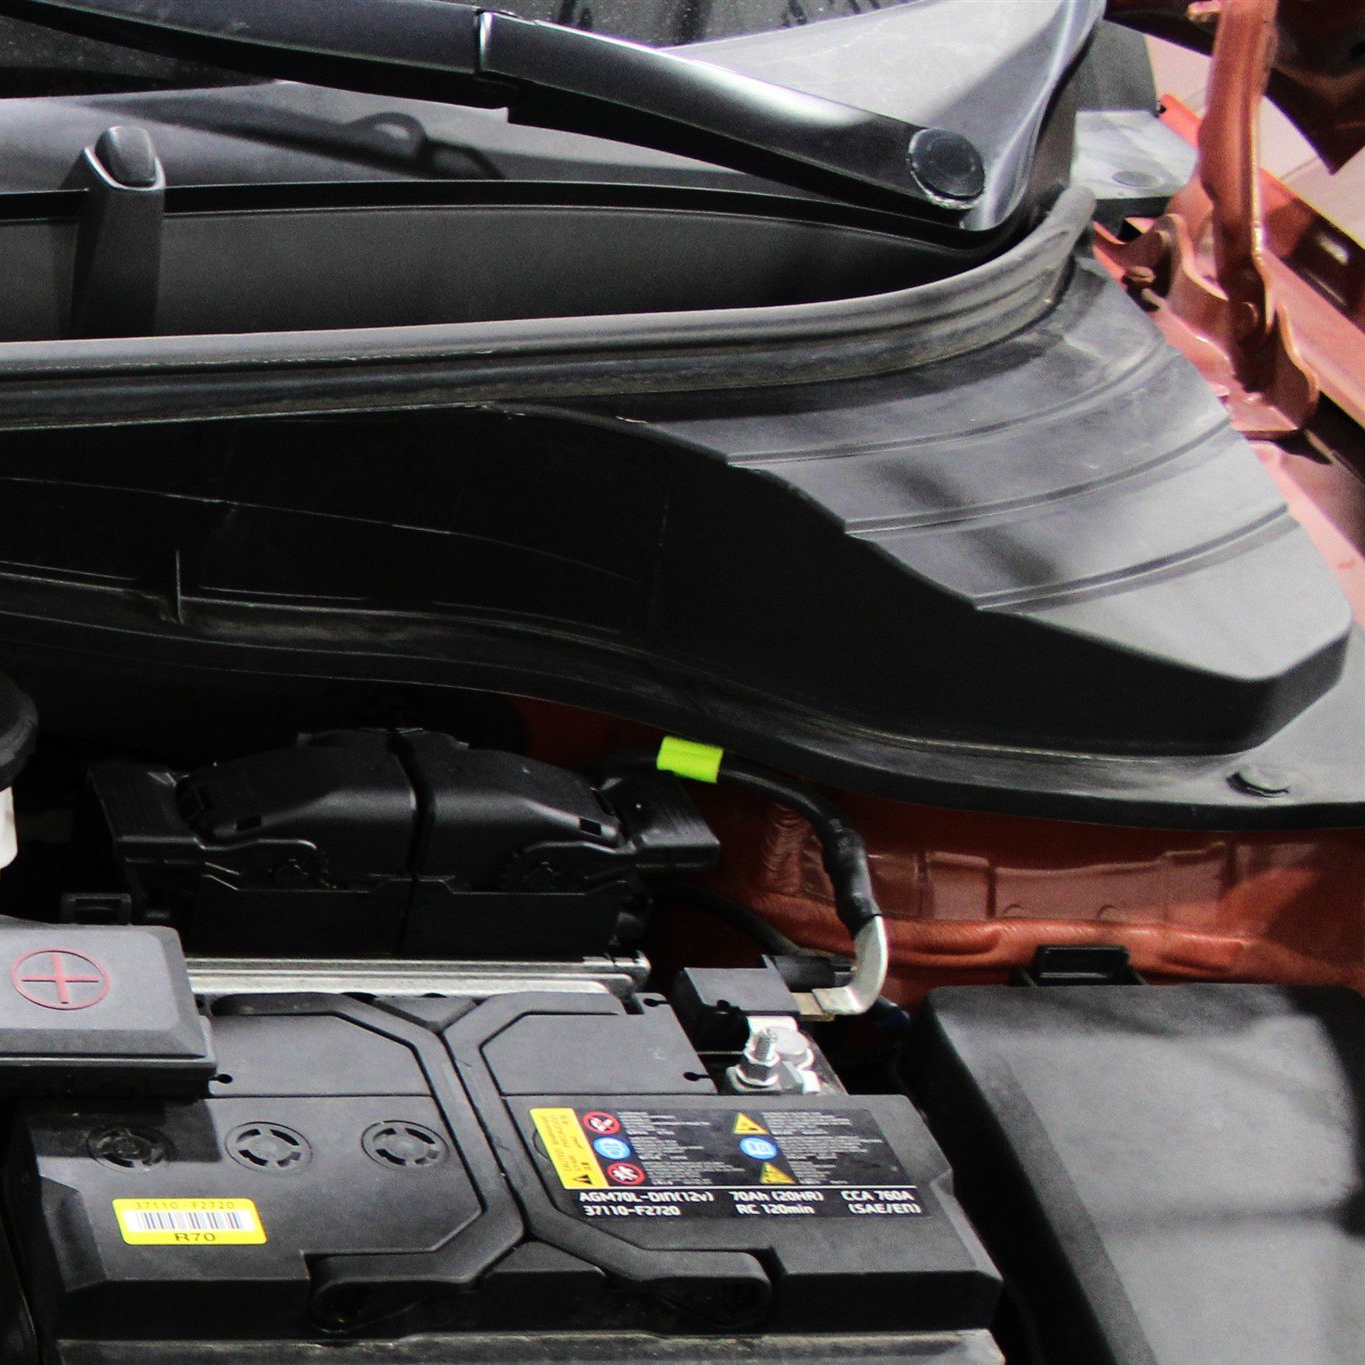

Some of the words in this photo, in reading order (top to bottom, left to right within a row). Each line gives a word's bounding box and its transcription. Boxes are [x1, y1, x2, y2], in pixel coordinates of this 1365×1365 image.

[729, 1191, 769, 1202] 70Ah
[771, 1191, 824, 1202] (20HR)
[840, 1191, 871, 1202] CCA
[874, 1191, 914, 1202] 760A
[135, 1201, 235, 1210] 37110-F2720
[583, 1205, 681, 1216] 37110-F2720
[736, 1204, 760, 1215] RC
[762, 1204, 815, 1215] 120min
[174, 1233, 216, 1242] R70
